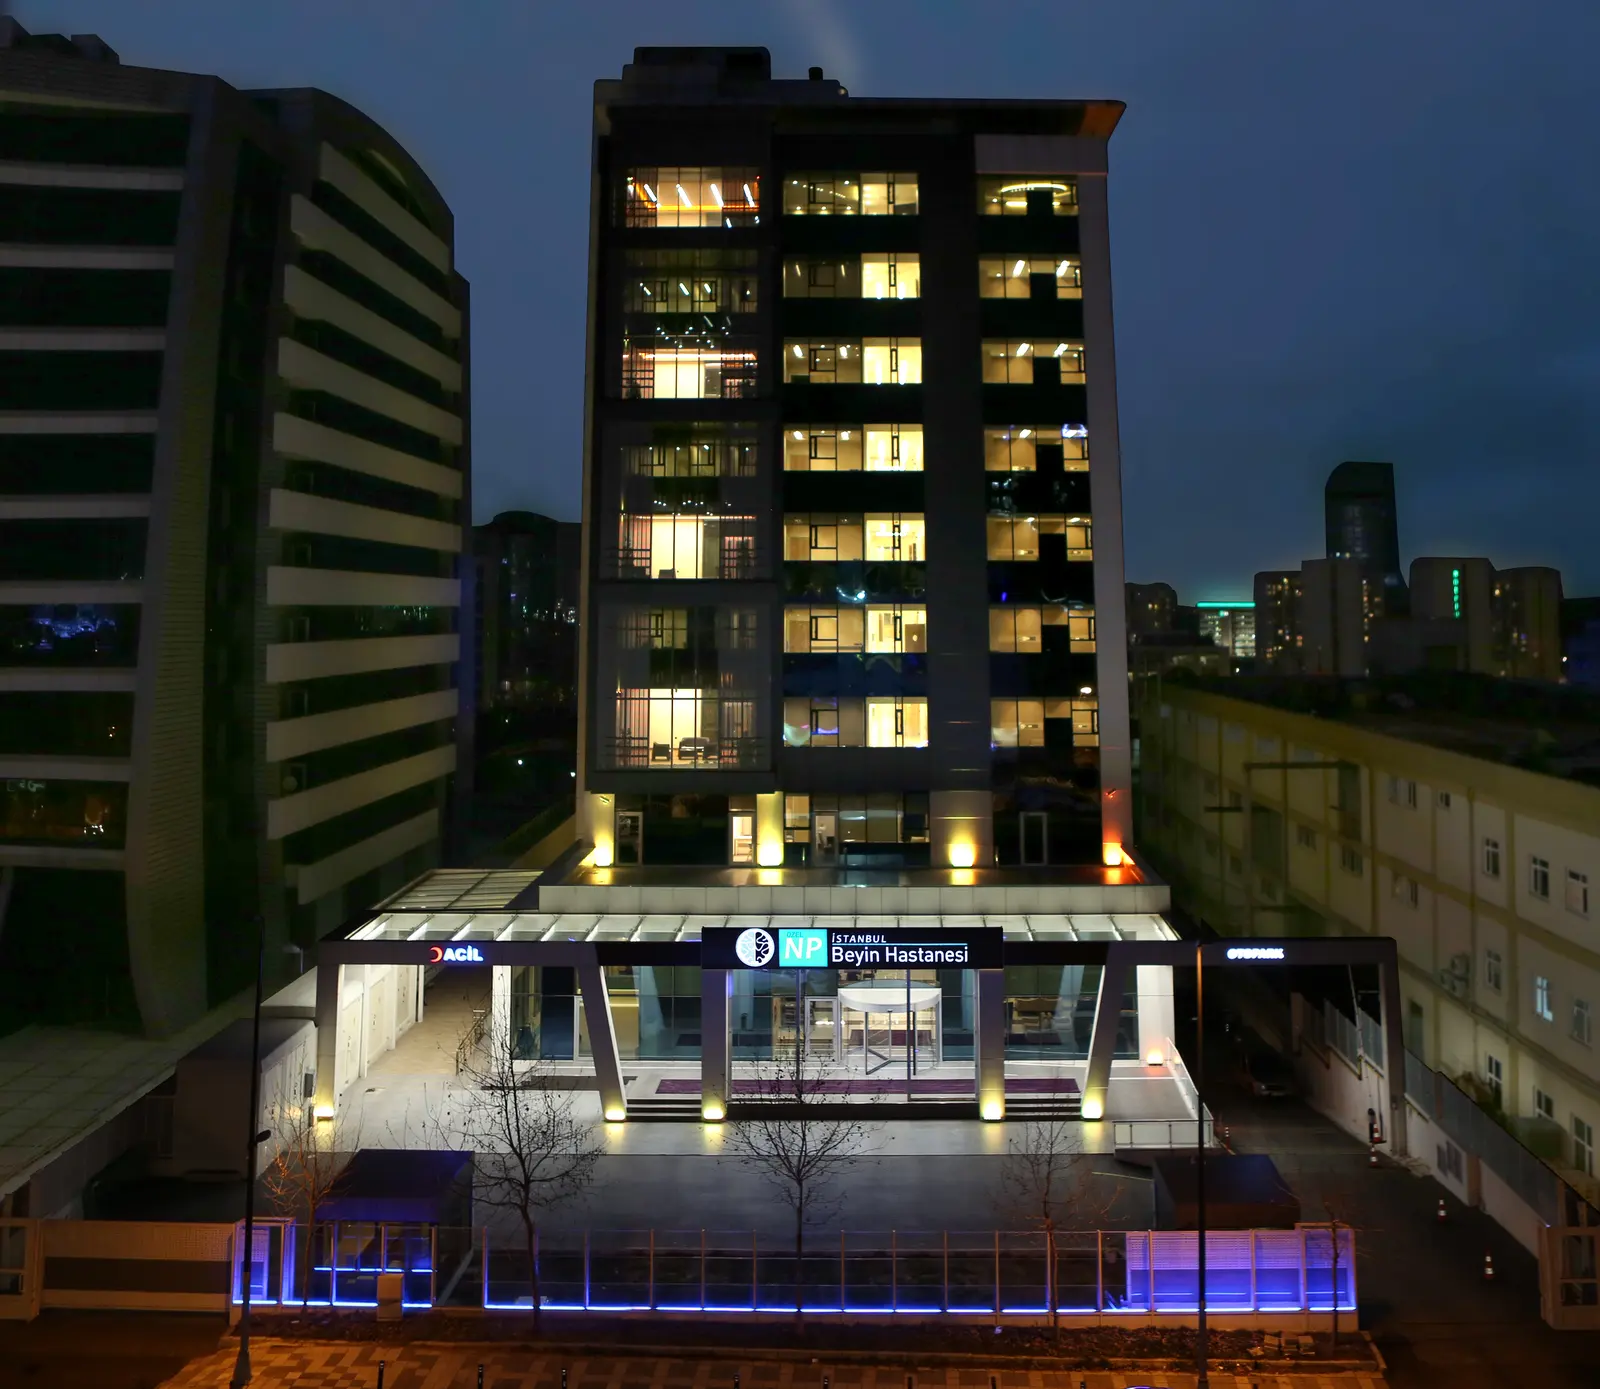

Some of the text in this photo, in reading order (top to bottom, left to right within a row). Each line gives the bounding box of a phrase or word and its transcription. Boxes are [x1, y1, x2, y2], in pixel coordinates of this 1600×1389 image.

[832, 933, 887, 943] İSTANBUL
[443, 945, 484, 961] ACİL
[784, 937, 823, 959] NP
[832, 946, 969, 966] Beyin Hastanesi
